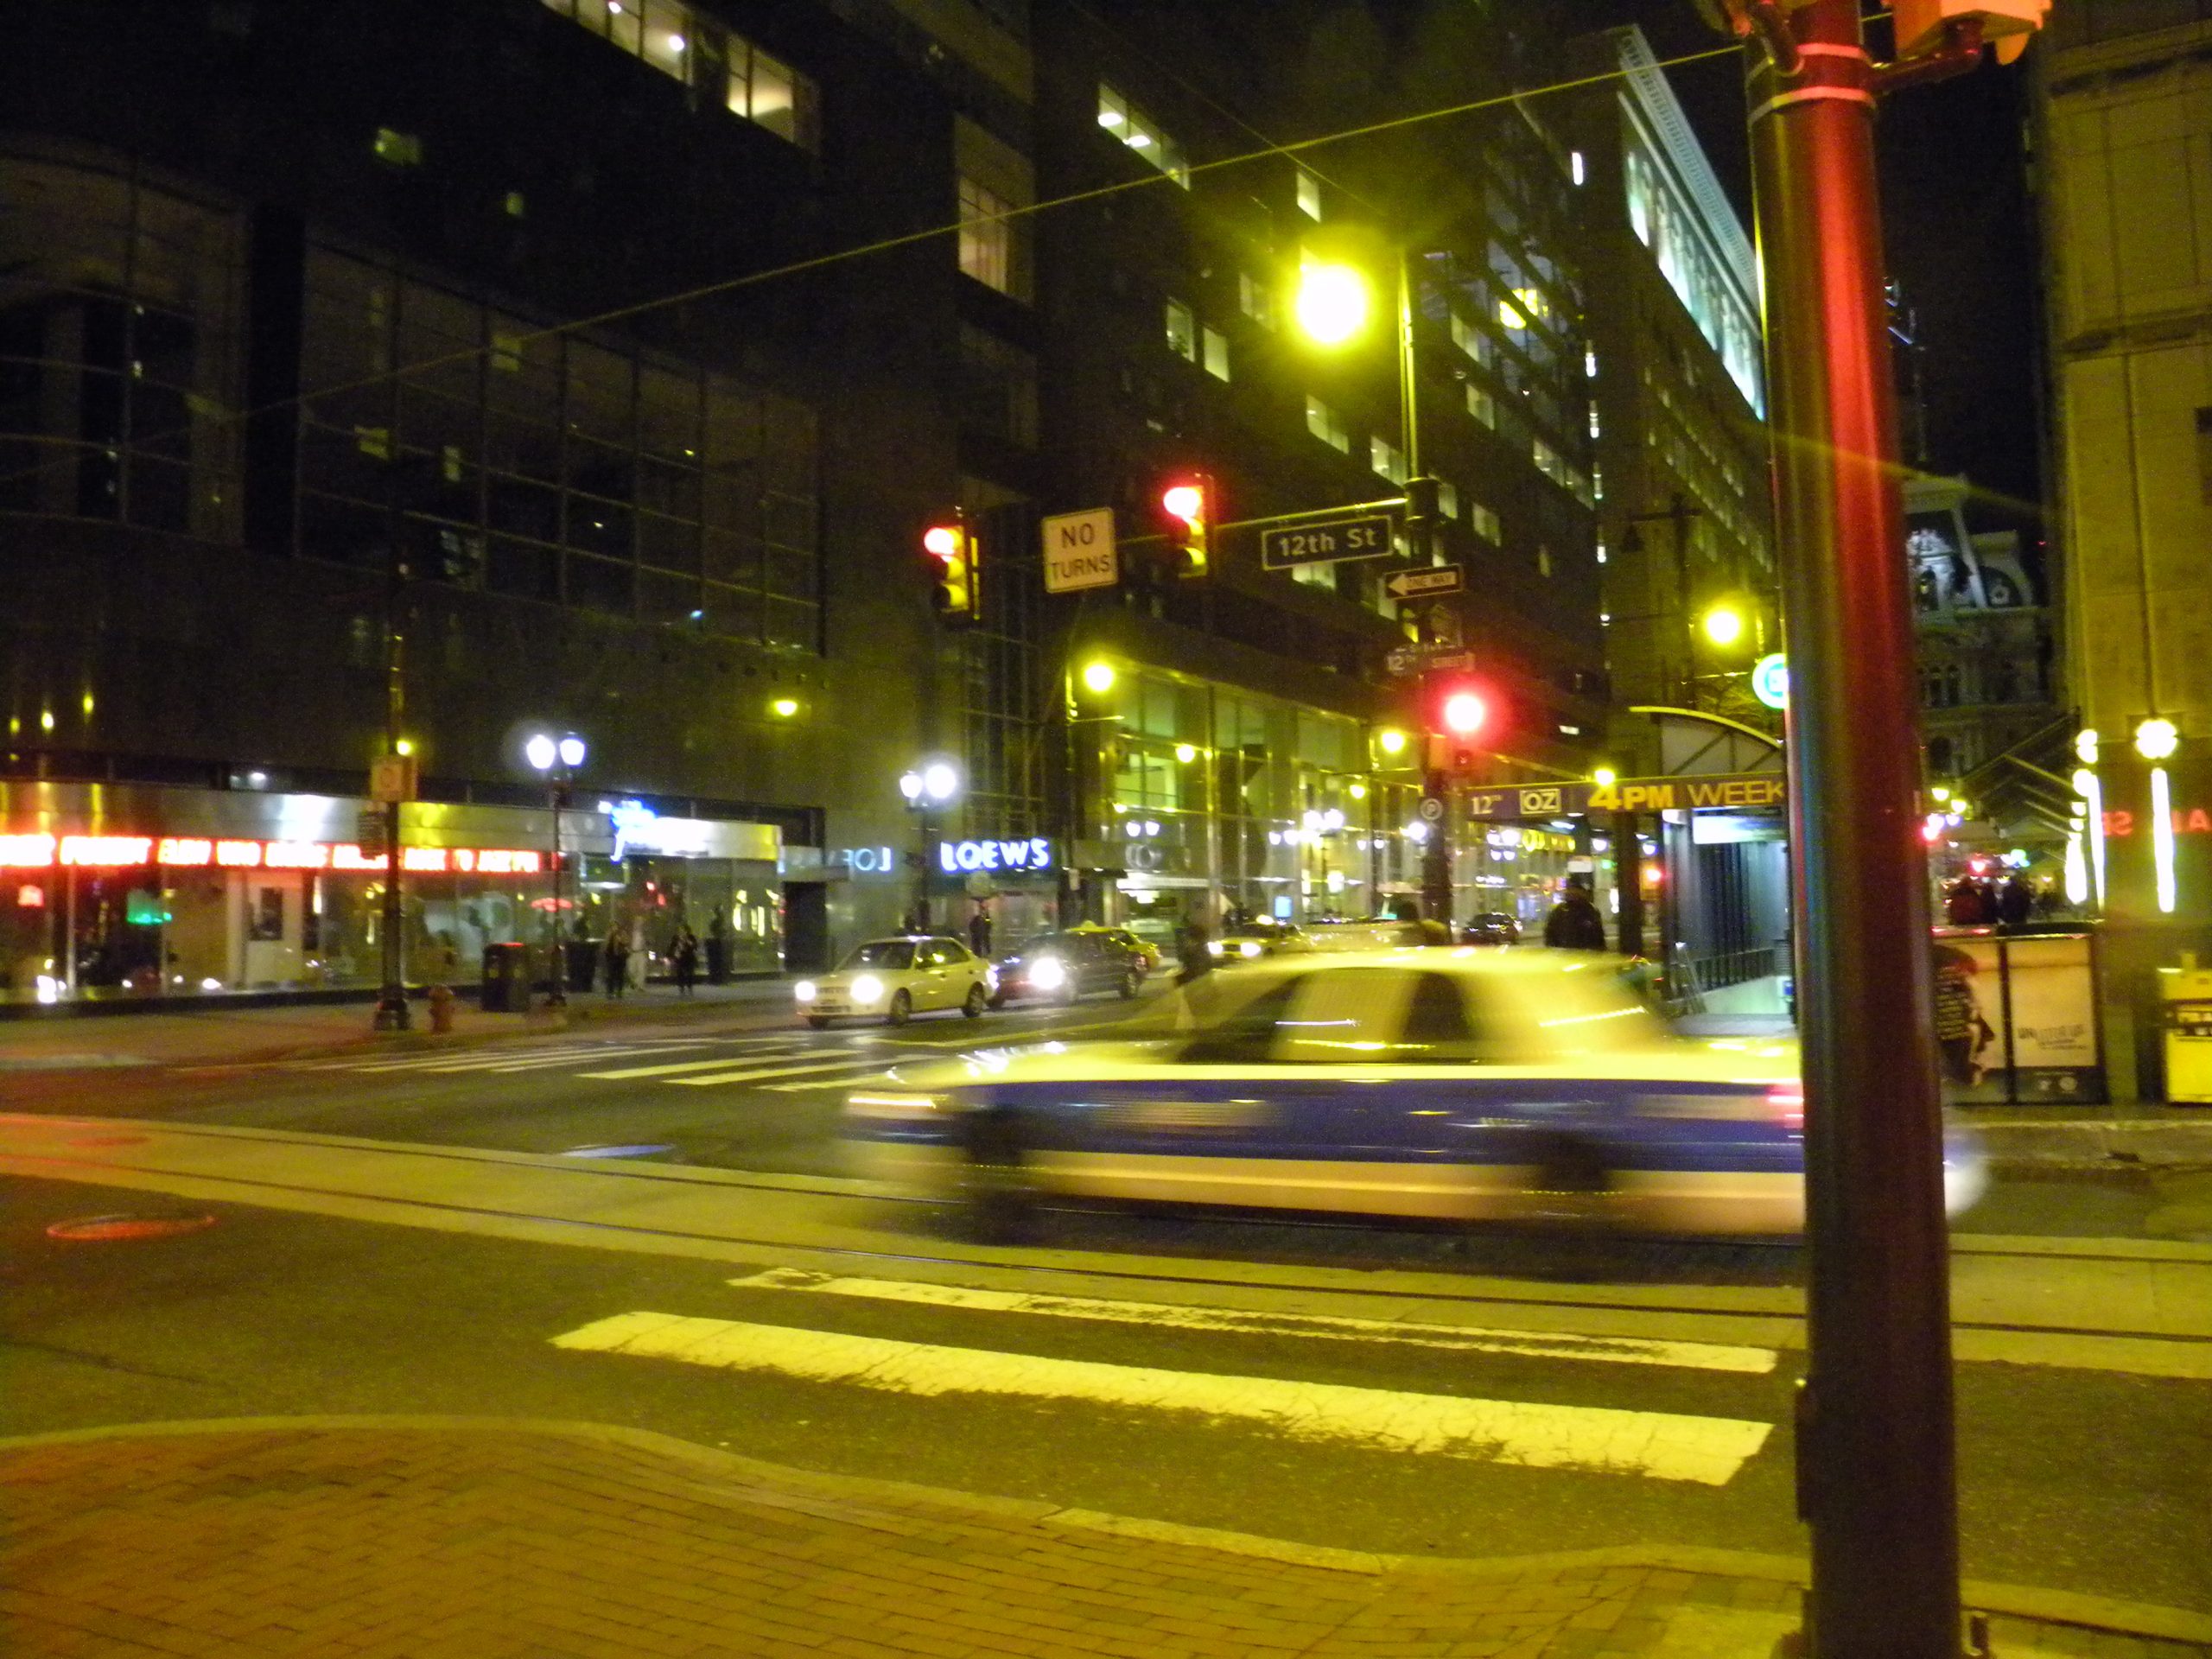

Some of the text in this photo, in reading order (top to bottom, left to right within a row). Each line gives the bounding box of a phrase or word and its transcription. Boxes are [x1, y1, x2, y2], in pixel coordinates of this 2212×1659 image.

[1061, 523, 1095, 549] NO
[1280, 528, 1376, 556] 12th St
[1051, 554, 1110, 580] TURNS
[1587, 785, 1675, 810] 4PM
[940, 836, 1050, 873] LOEWS
